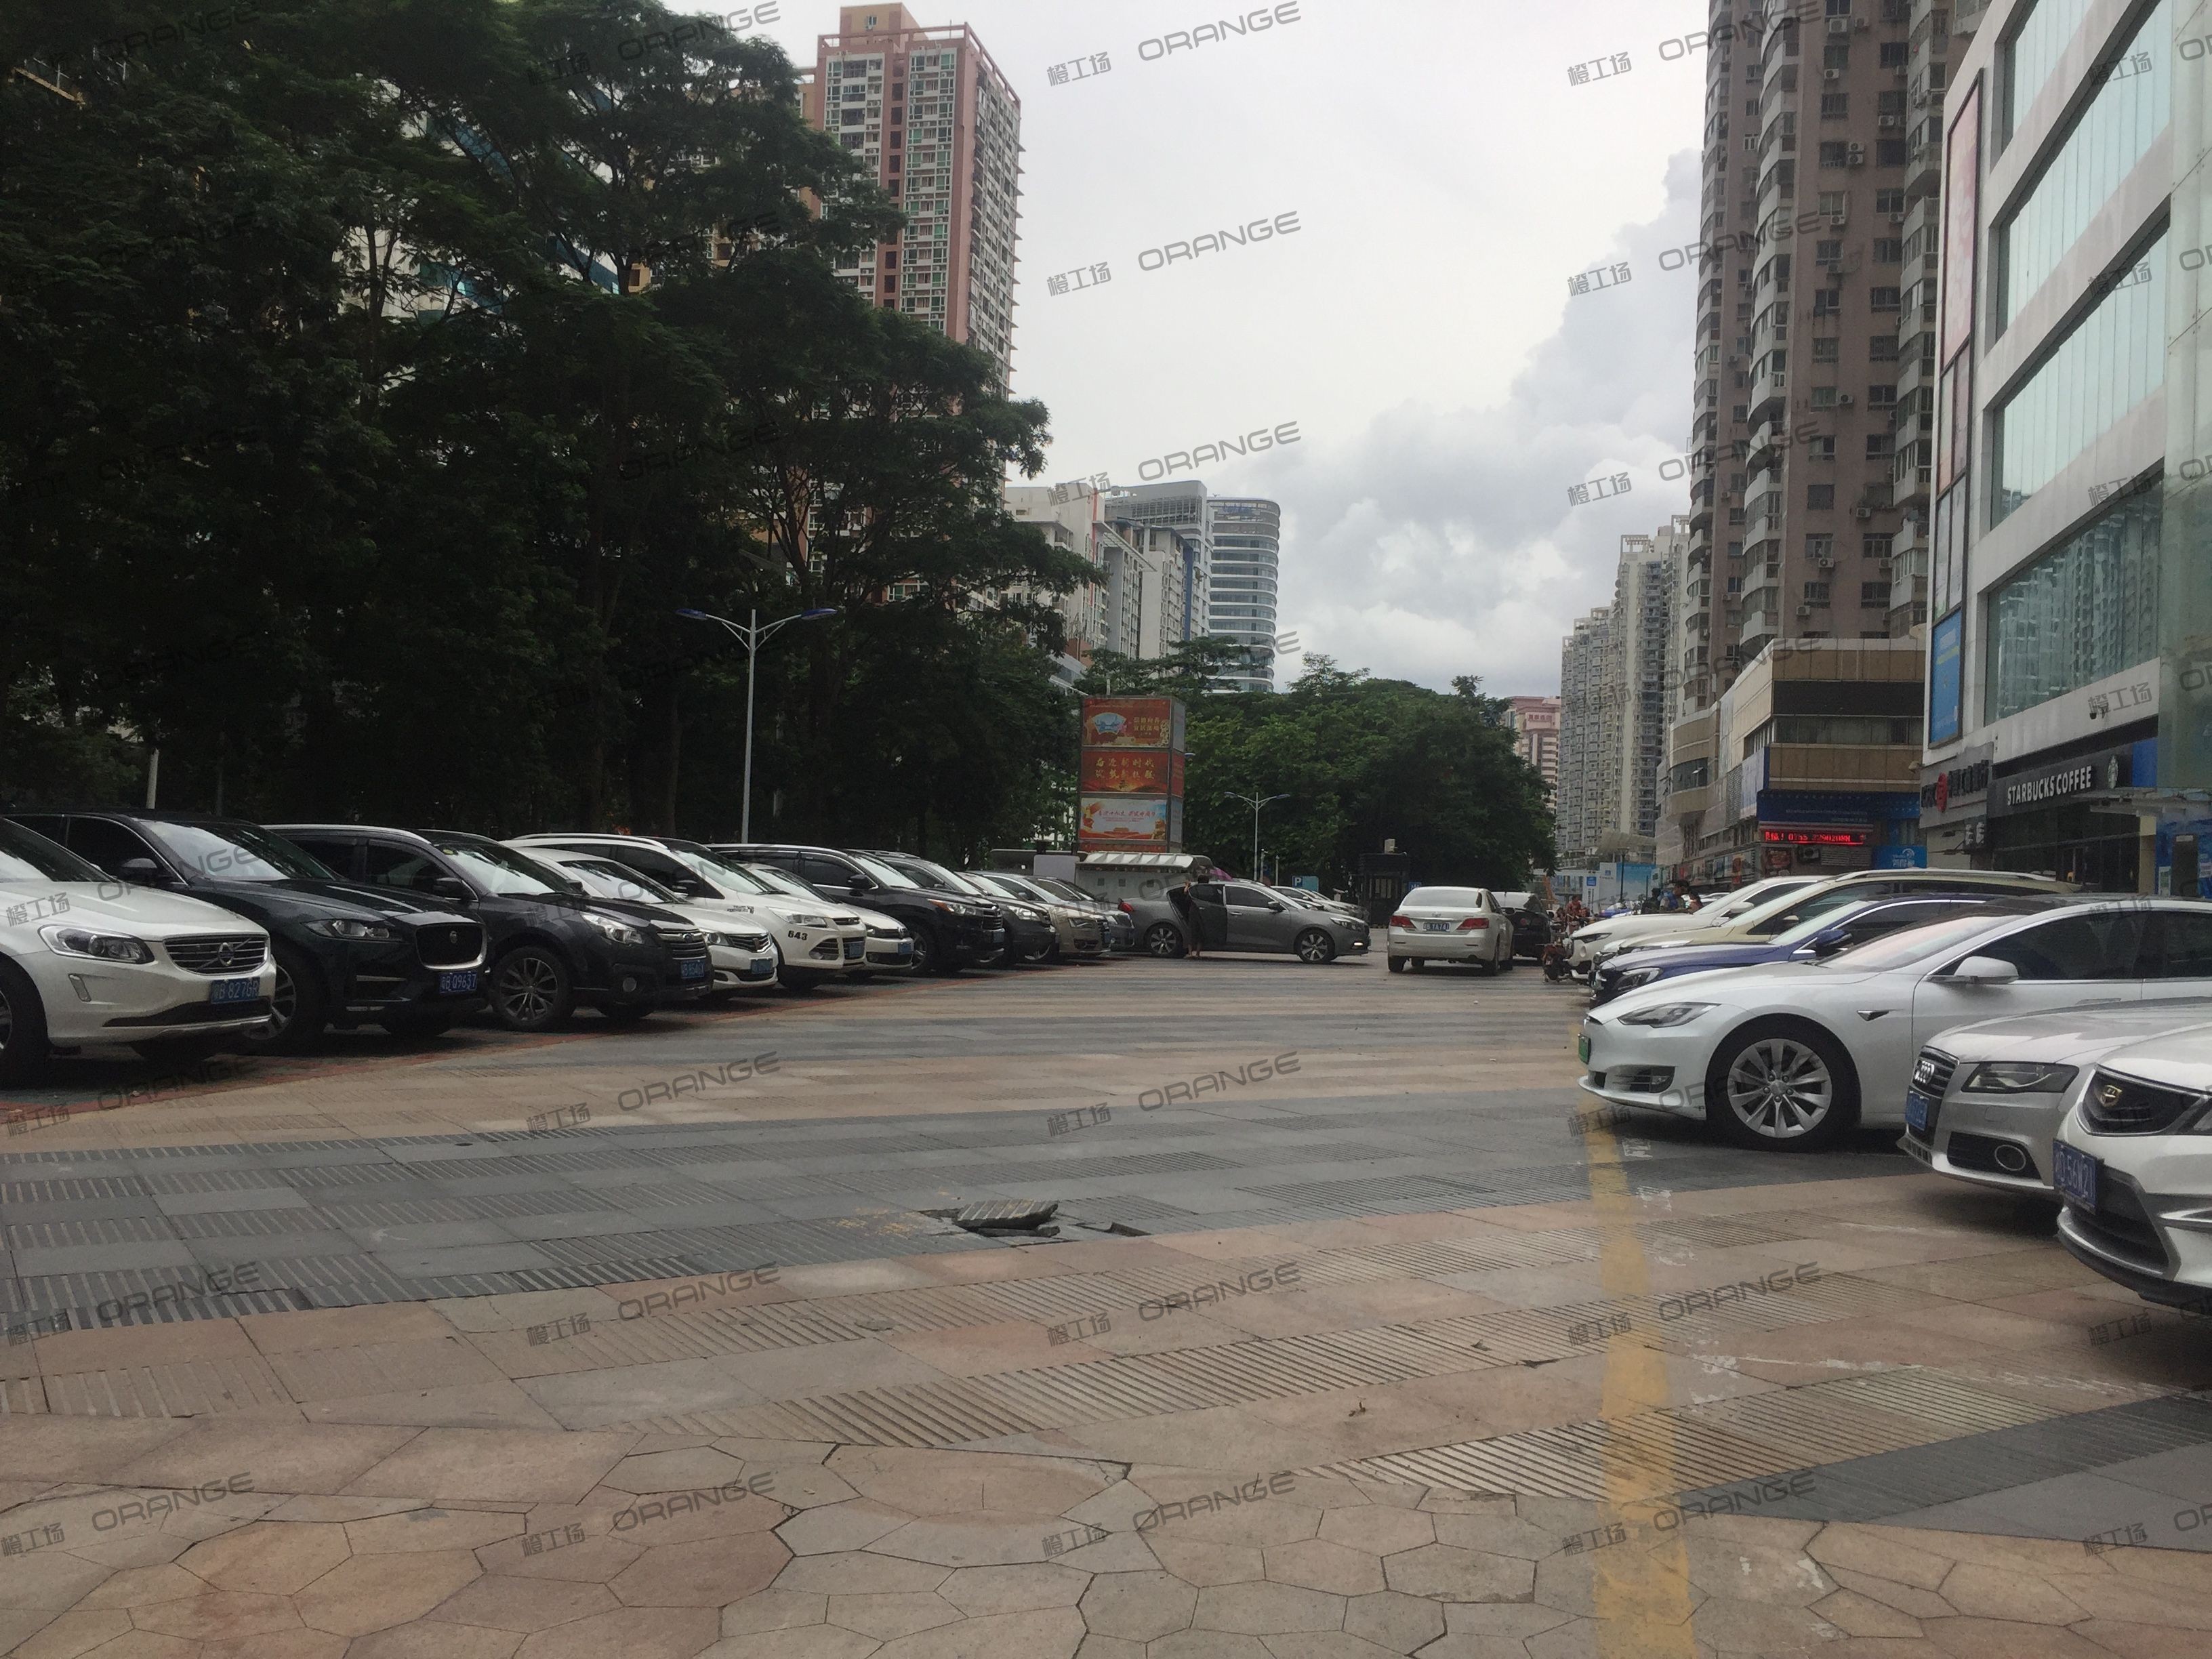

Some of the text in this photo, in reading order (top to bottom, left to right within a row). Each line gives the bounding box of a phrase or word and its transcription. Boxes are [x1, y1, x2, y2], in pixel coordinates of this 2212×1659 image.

[2007, 775, 2055, 806] STARBUCKS
[2056, 765, 2092, 795] COFFEE
[1294, 877, 1302, 886] P
[787, 930, 808, 941] 643
